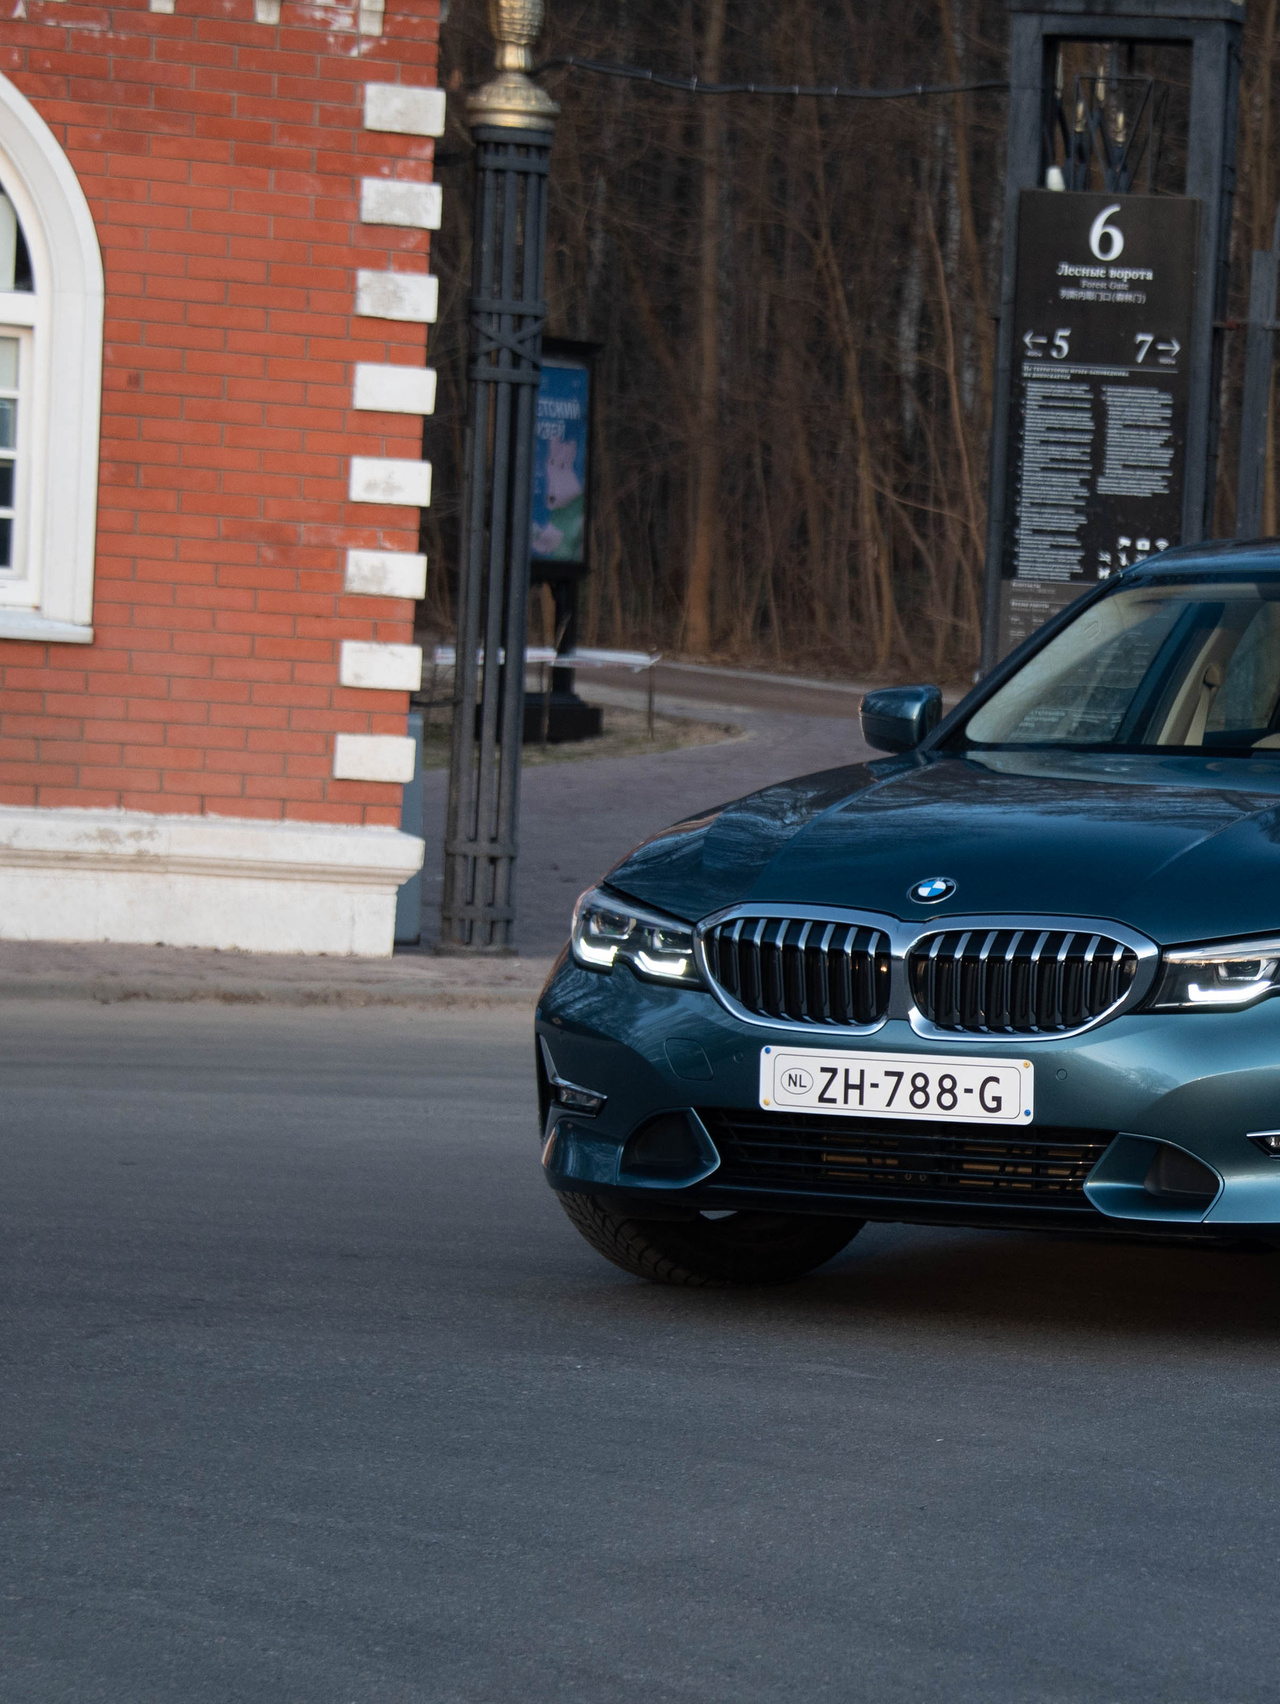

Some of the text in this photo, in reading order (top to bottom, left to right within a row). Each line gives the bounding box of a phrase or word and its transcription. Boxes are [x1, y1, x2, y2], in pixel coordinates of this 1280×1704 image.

[1089, 203, 1124, 261] 6
[1057, 262, 1153, 282] Лесные ворота
[1080, 279, 1129, 291] Forest Gate
[1050, 328, 1071, 359] 5
[1135, 333, 1154, 363] 7
[537, 396, 581, 420] ЕТСКИЙ
[537, 420, 566, 441] УЗЕЙ
[788, 1074, 807, 1088] NL
[818, 1067, 1002, 1113] ZH-788-G
